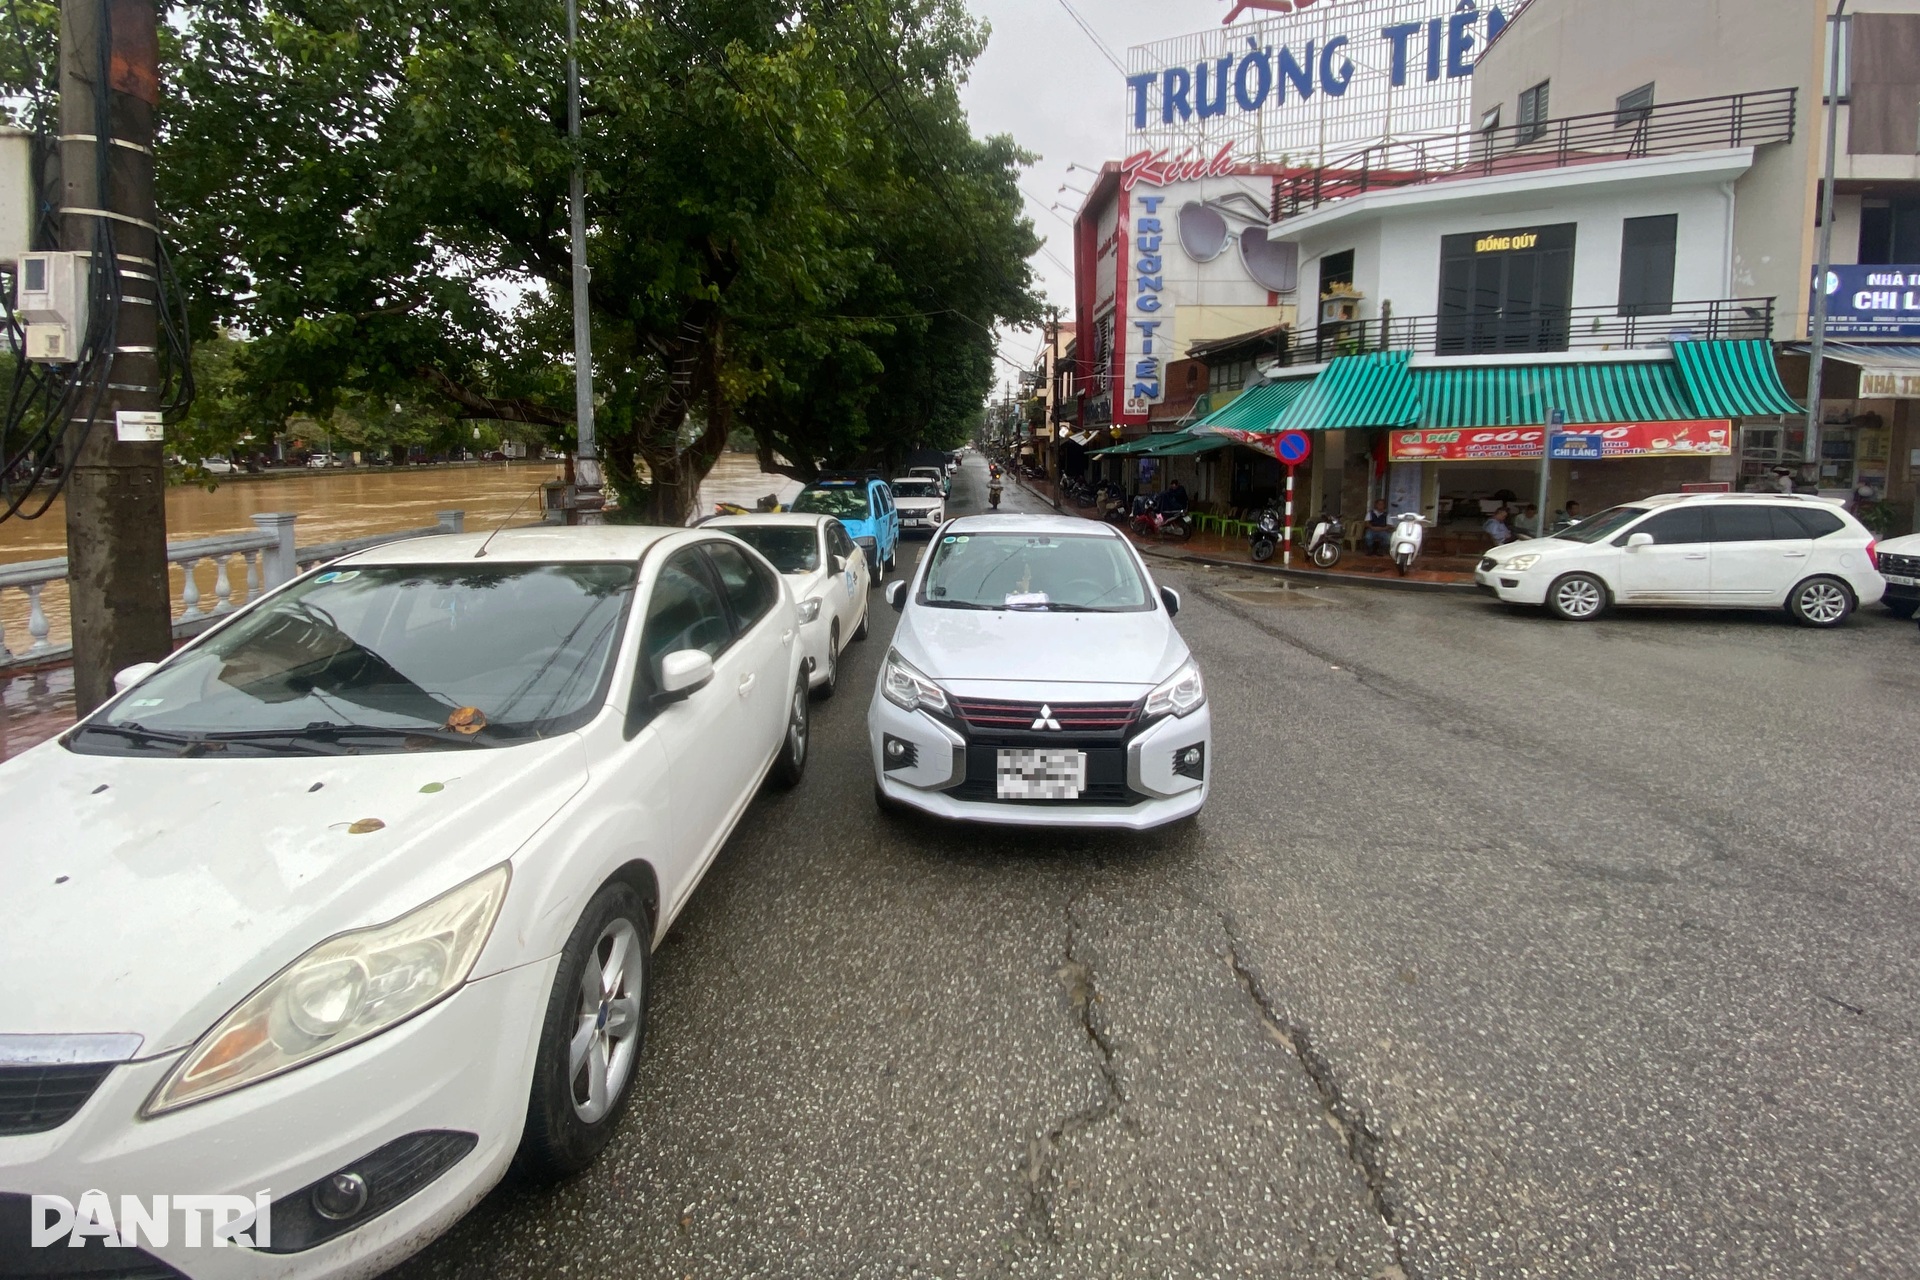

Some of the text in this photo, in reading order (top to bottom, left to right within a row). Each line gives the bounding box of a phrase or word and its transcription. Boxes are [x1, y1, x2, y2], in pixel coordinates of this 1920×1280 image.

[1127, 35, 1355, 128] TRƯỜNG
[1121, 141, 1237, 191] Kính
[1852, 291, 1920, 310] CHI L
[1472, 430, 1542, 442] GÓC
